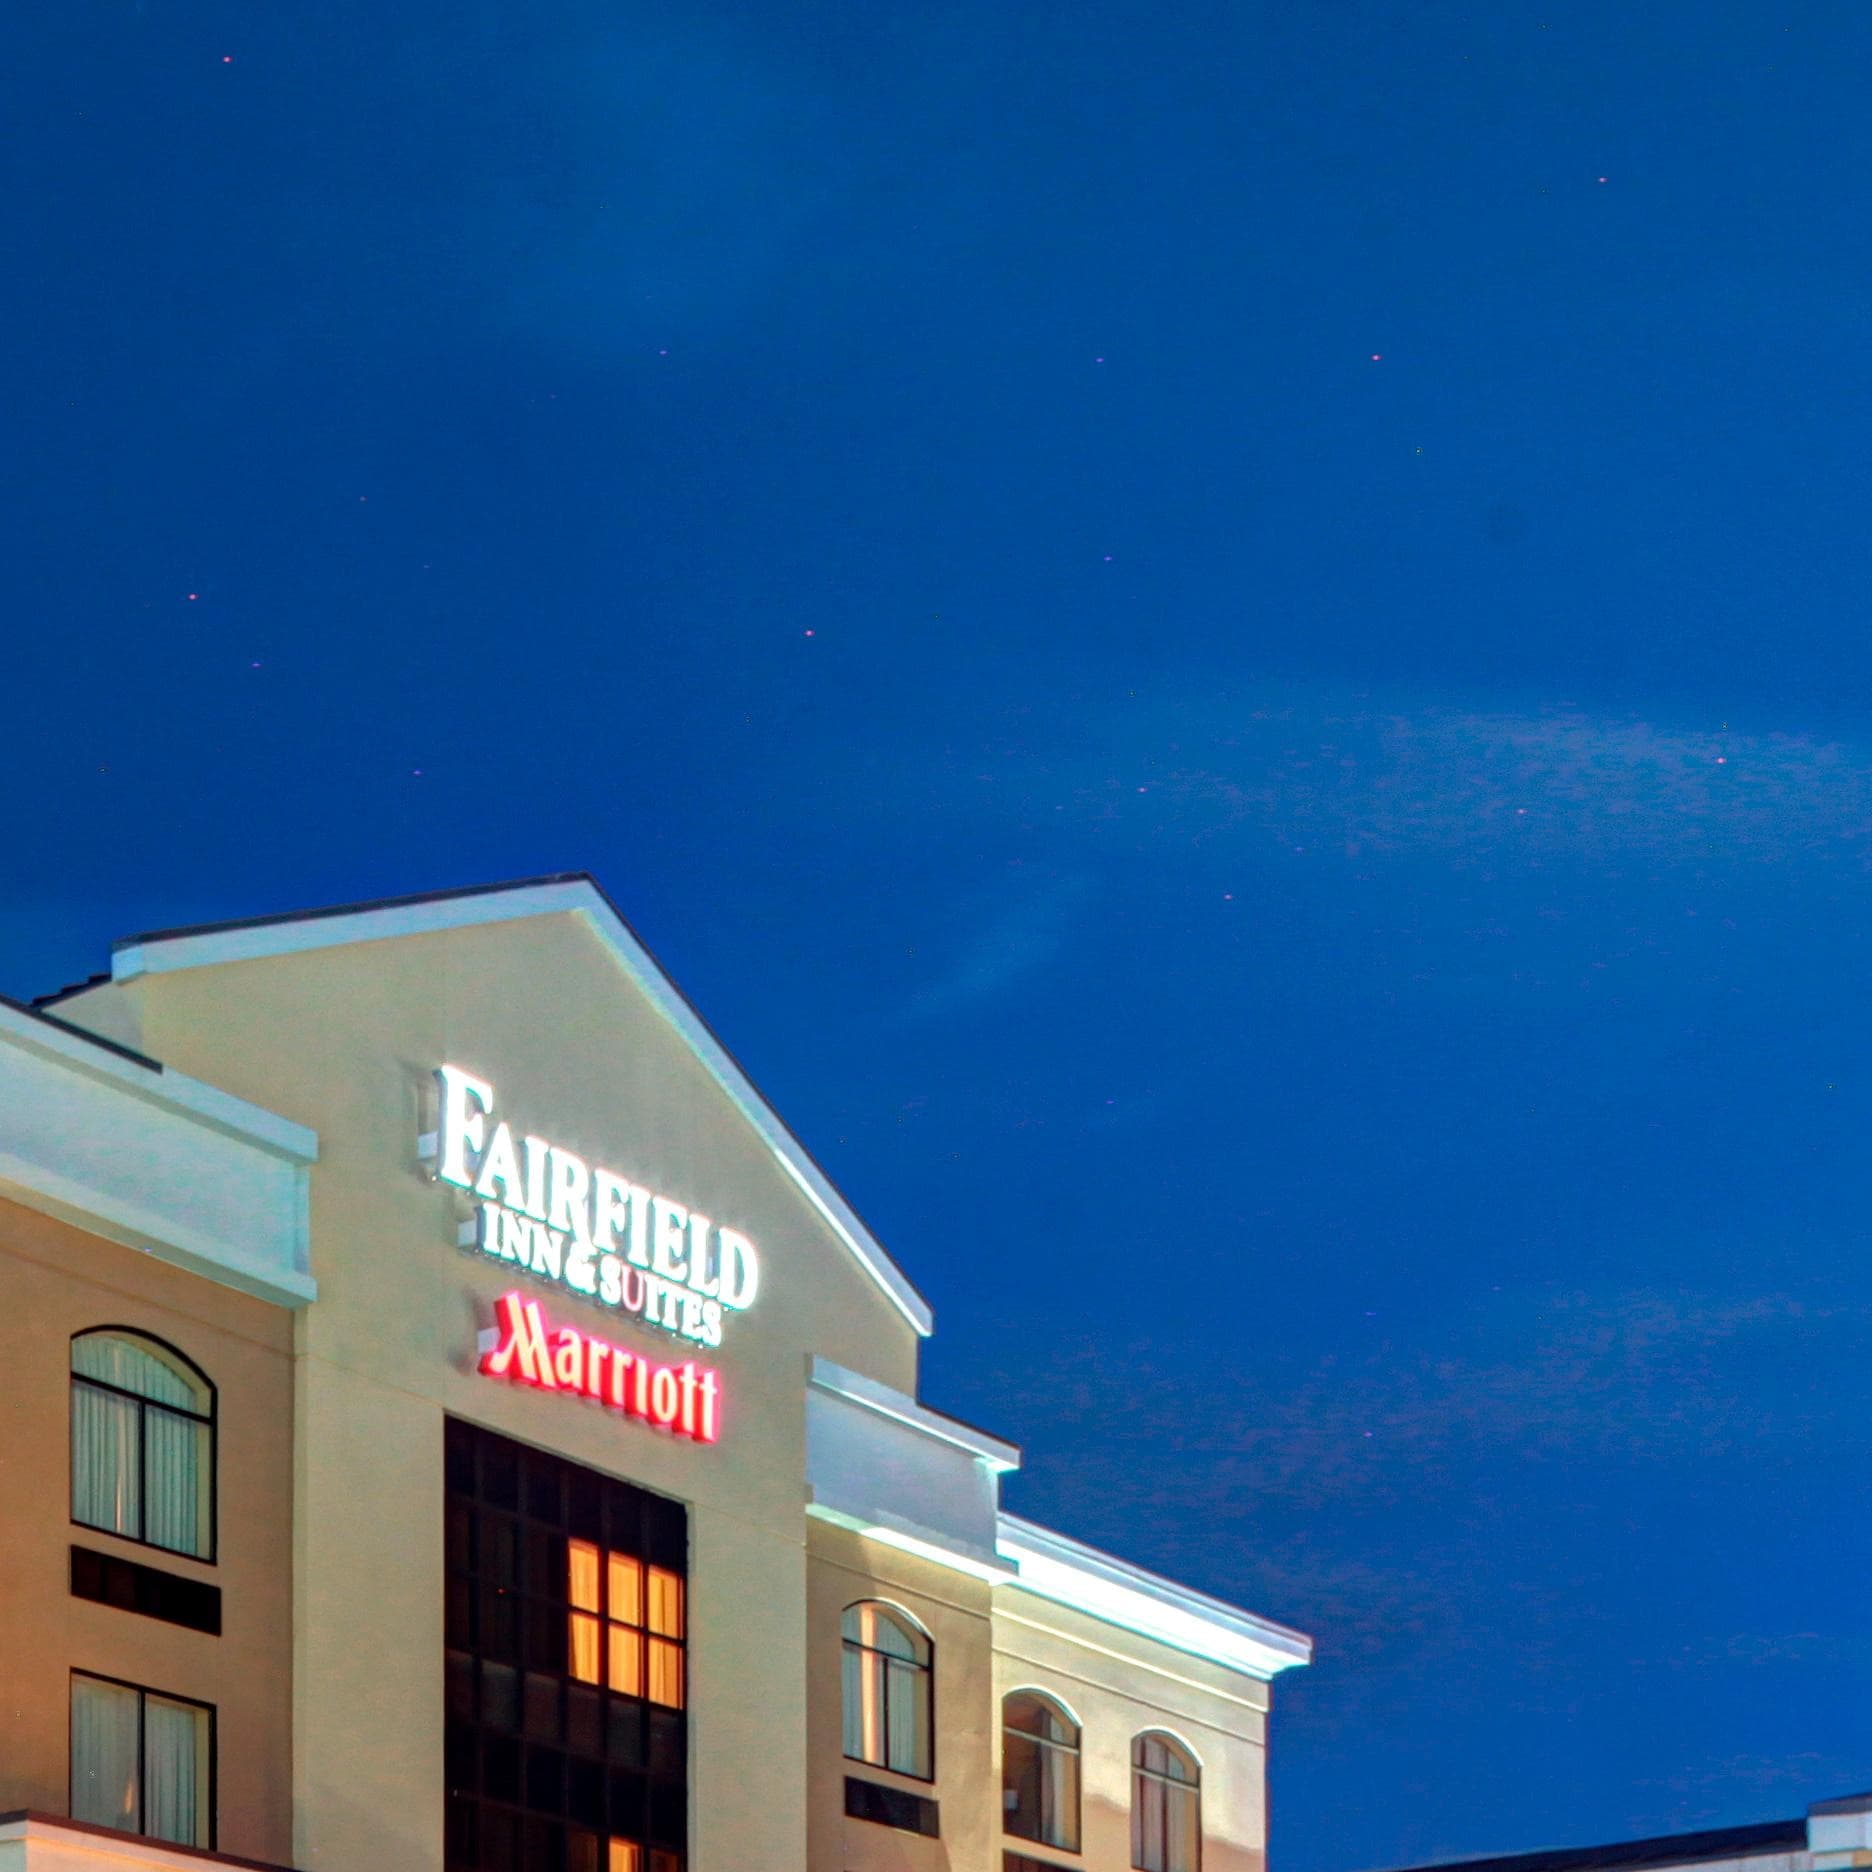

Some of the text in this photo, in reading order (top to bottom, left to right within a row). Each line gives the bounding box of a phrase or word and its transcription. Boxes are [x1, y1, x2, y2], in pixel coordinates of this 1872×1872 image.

[438, 1063, 760, 1311] FAIRFIELD
[480, 1202, 565, 1281] INN
[598, 1254, 724, 1349] SUITES
[480, 1291, 720, 1443] Marriott
